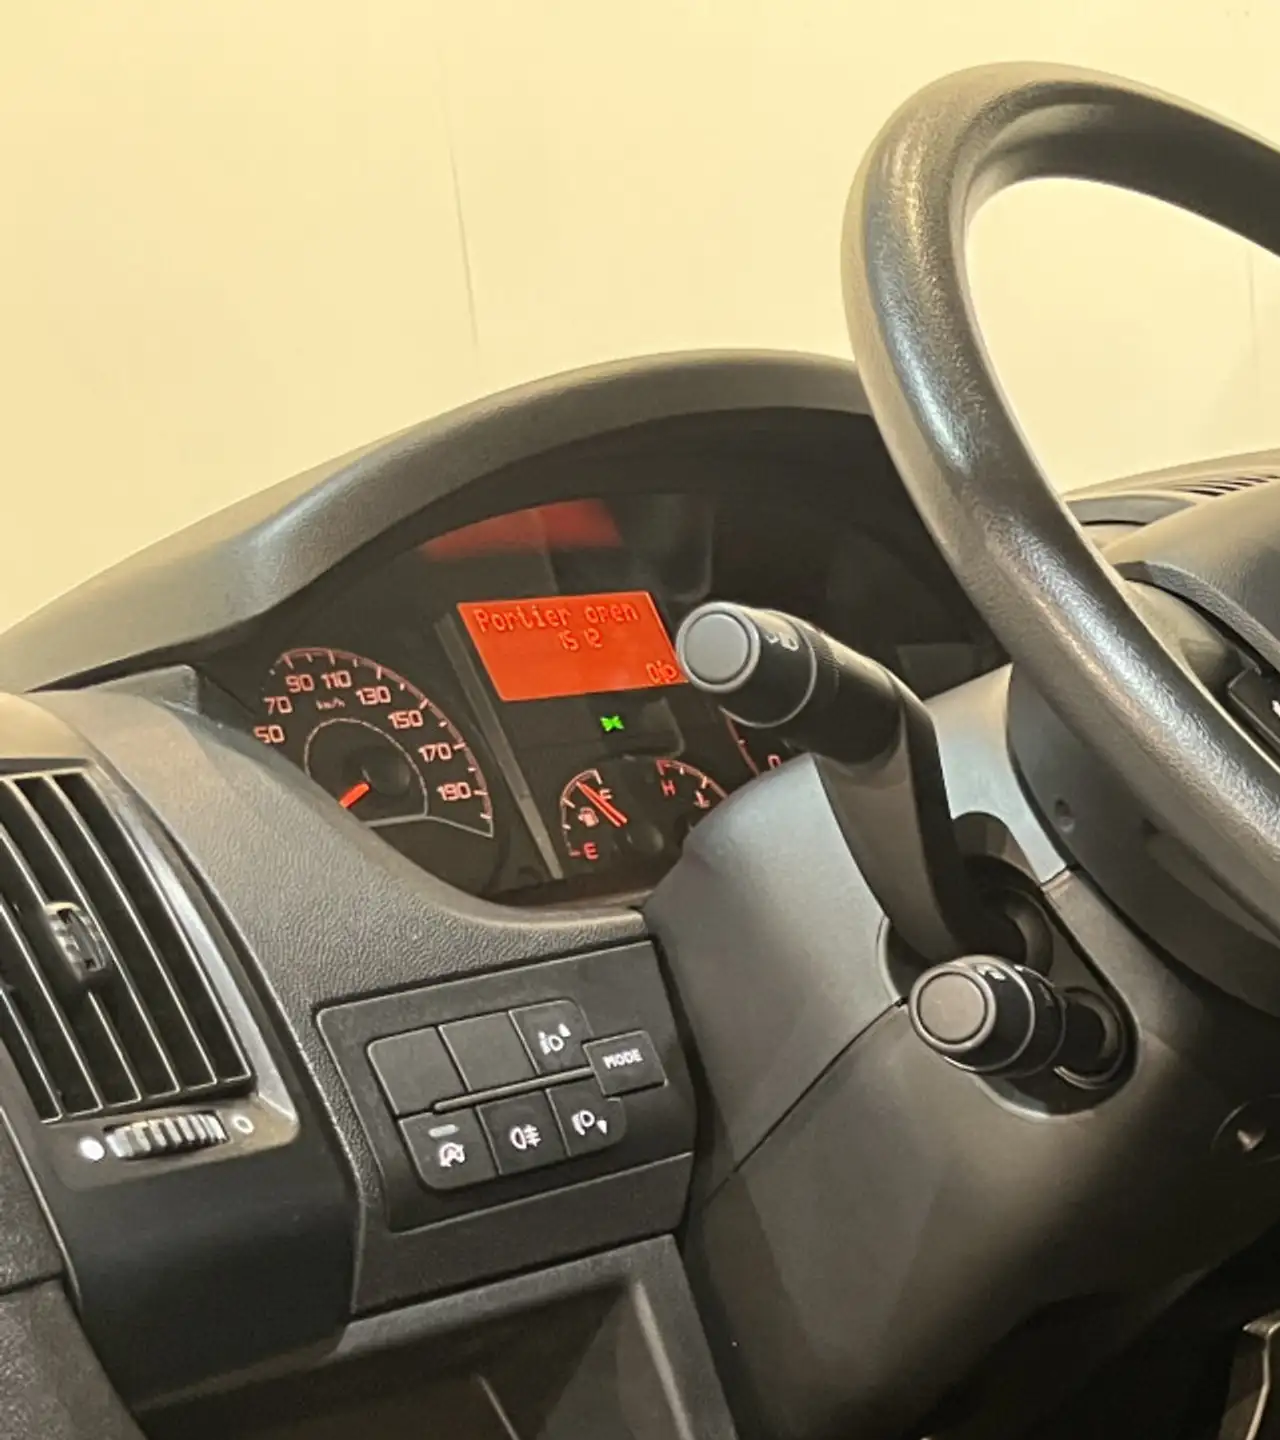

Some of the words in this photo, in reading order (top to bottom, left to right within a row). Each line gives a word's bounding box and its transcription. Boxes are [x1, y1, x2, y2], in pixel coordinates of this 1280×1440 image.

[472, 604, 571, 633] Portier
[583, 602, 640, 624] open
[284, 673, 315, 693] 90
[321, 670, 352, 690] 110
[356, 686, 391, 705] 130
[264, 696, 293, 716] 70
[387, 709, 424, 729] 150
[253, 724, 286, 744] 50
[418, 742, 453, 763] 170
[436, 781, 472, 801] 190
[660, 779, 677, 797] H
[583, 842, 600, 861] E
[602, 1047, 644, 1070] MODE
